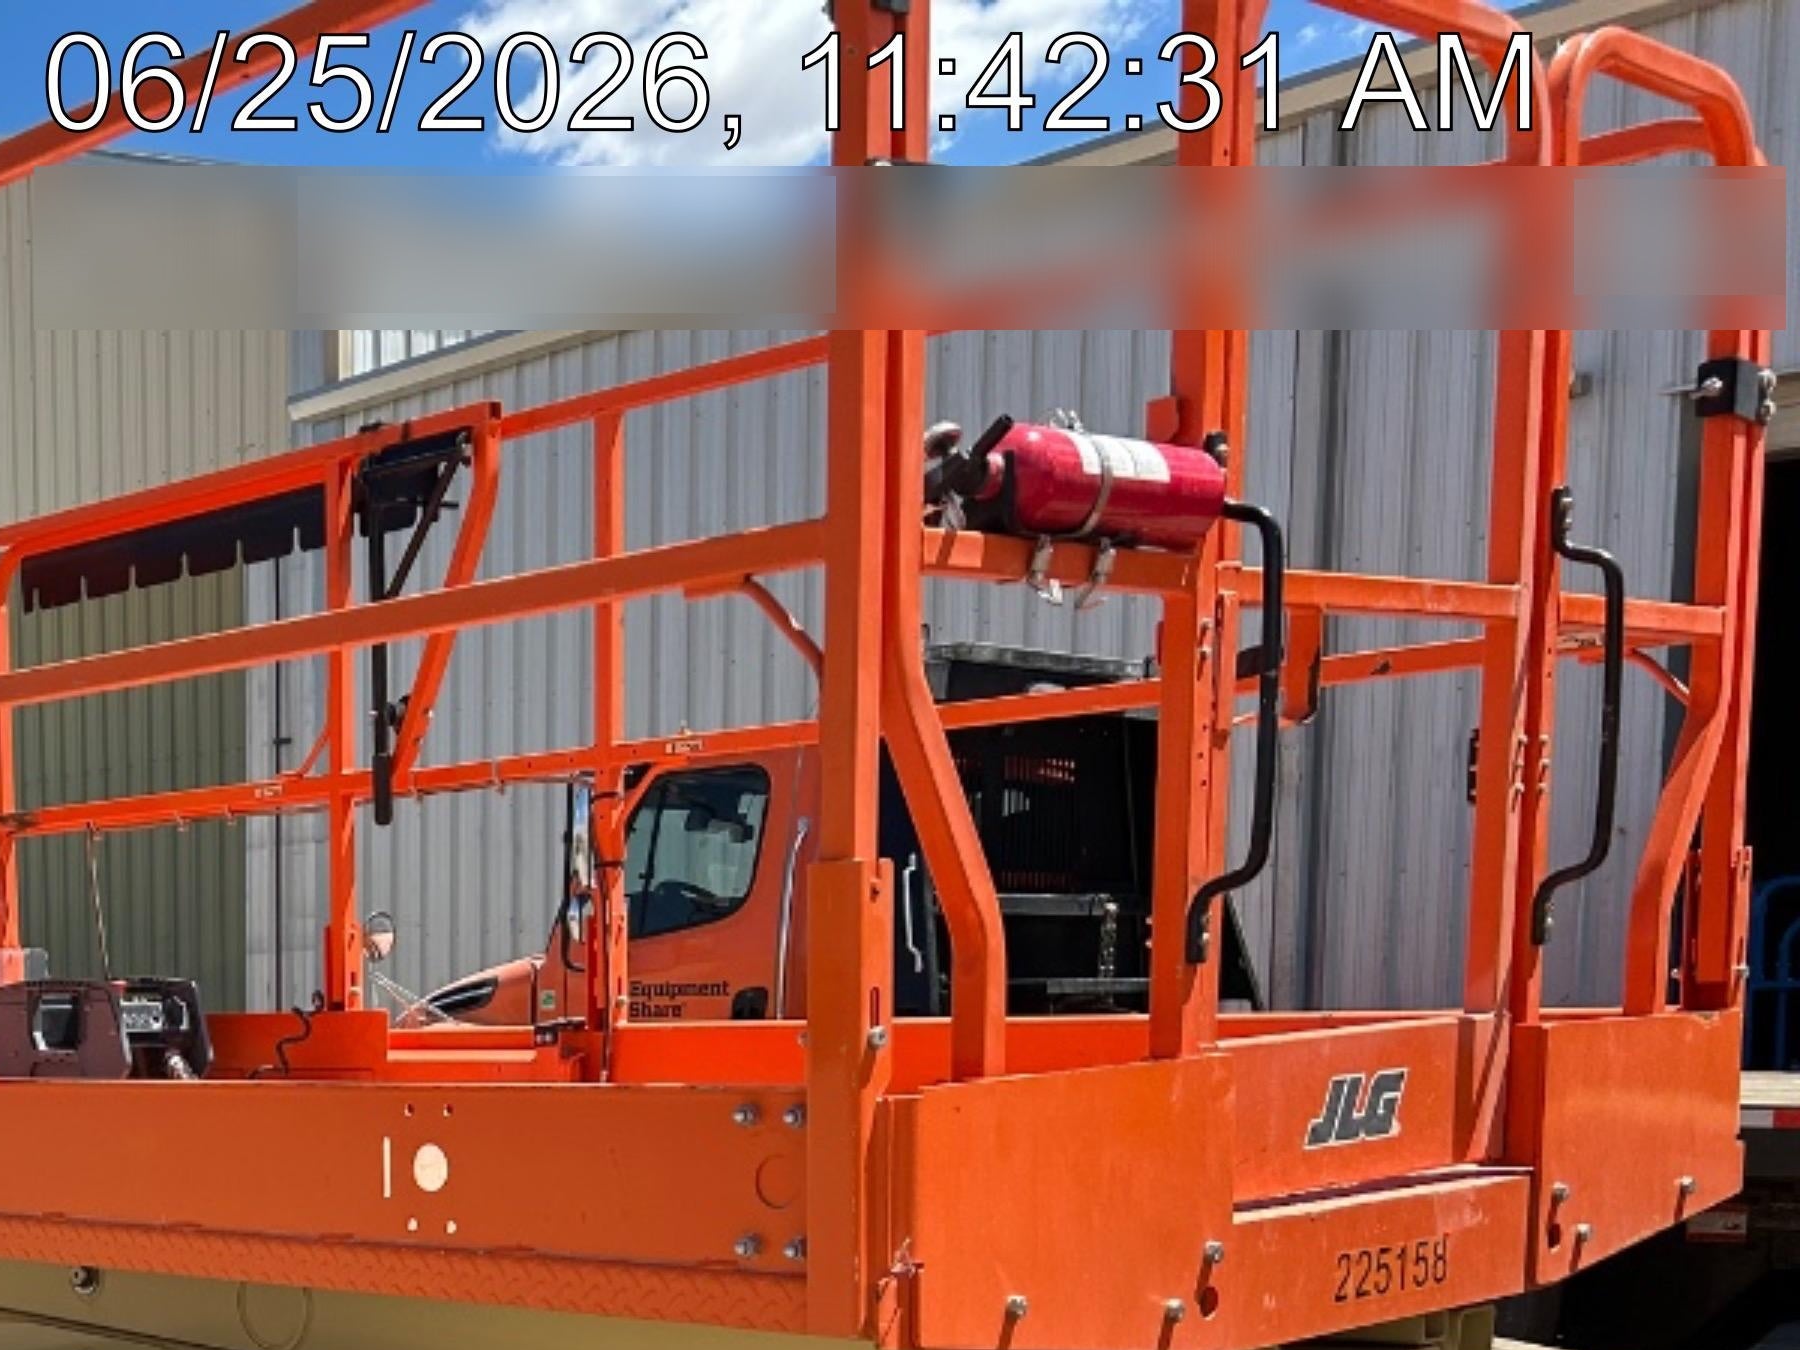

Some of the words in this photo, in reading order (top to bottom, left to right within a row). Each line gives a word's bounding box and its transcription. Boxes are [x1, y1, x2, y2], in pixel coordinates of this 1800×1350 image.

[630, 980, 729, 1000] Equipment
[630, 1002, 681, 1018] Share
[1304, 1068, 1408, 1149] JLG
[1334, 1232, 1449, 1302] 225158
